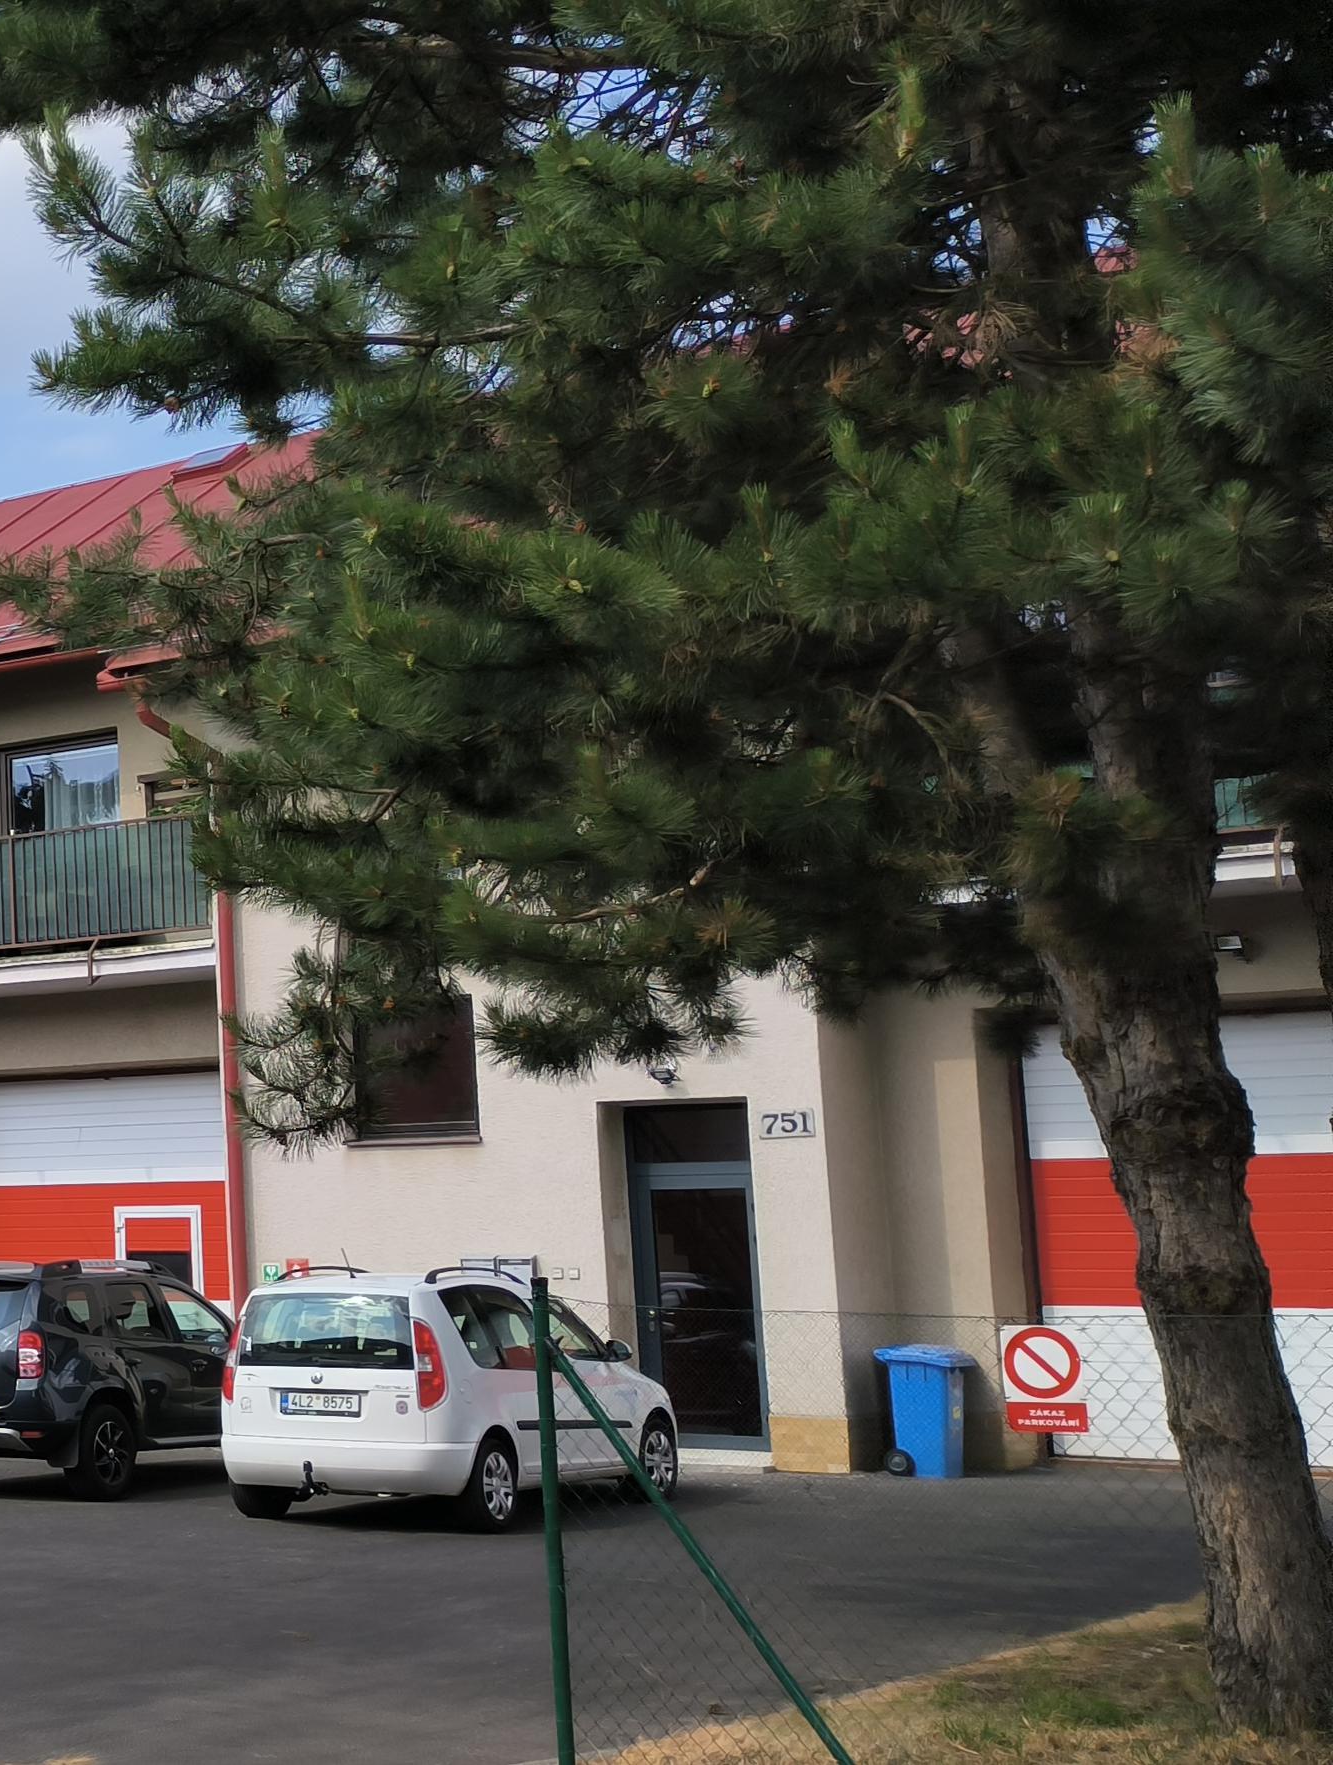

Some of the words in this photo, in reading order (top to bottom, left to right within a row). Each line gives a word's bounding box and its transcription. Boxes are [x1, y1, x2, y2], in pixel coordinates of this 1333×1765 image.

[762, 1110, 812, 1134] 751
[291, 1395, 314, 1408] 4L2
[323, 1396, 353, 1409] 8575
[1029, 1407, 1066, 1417] ZÁKAZ
[1017, 1418, 1079, 1427] PARKOVÁNÍ
